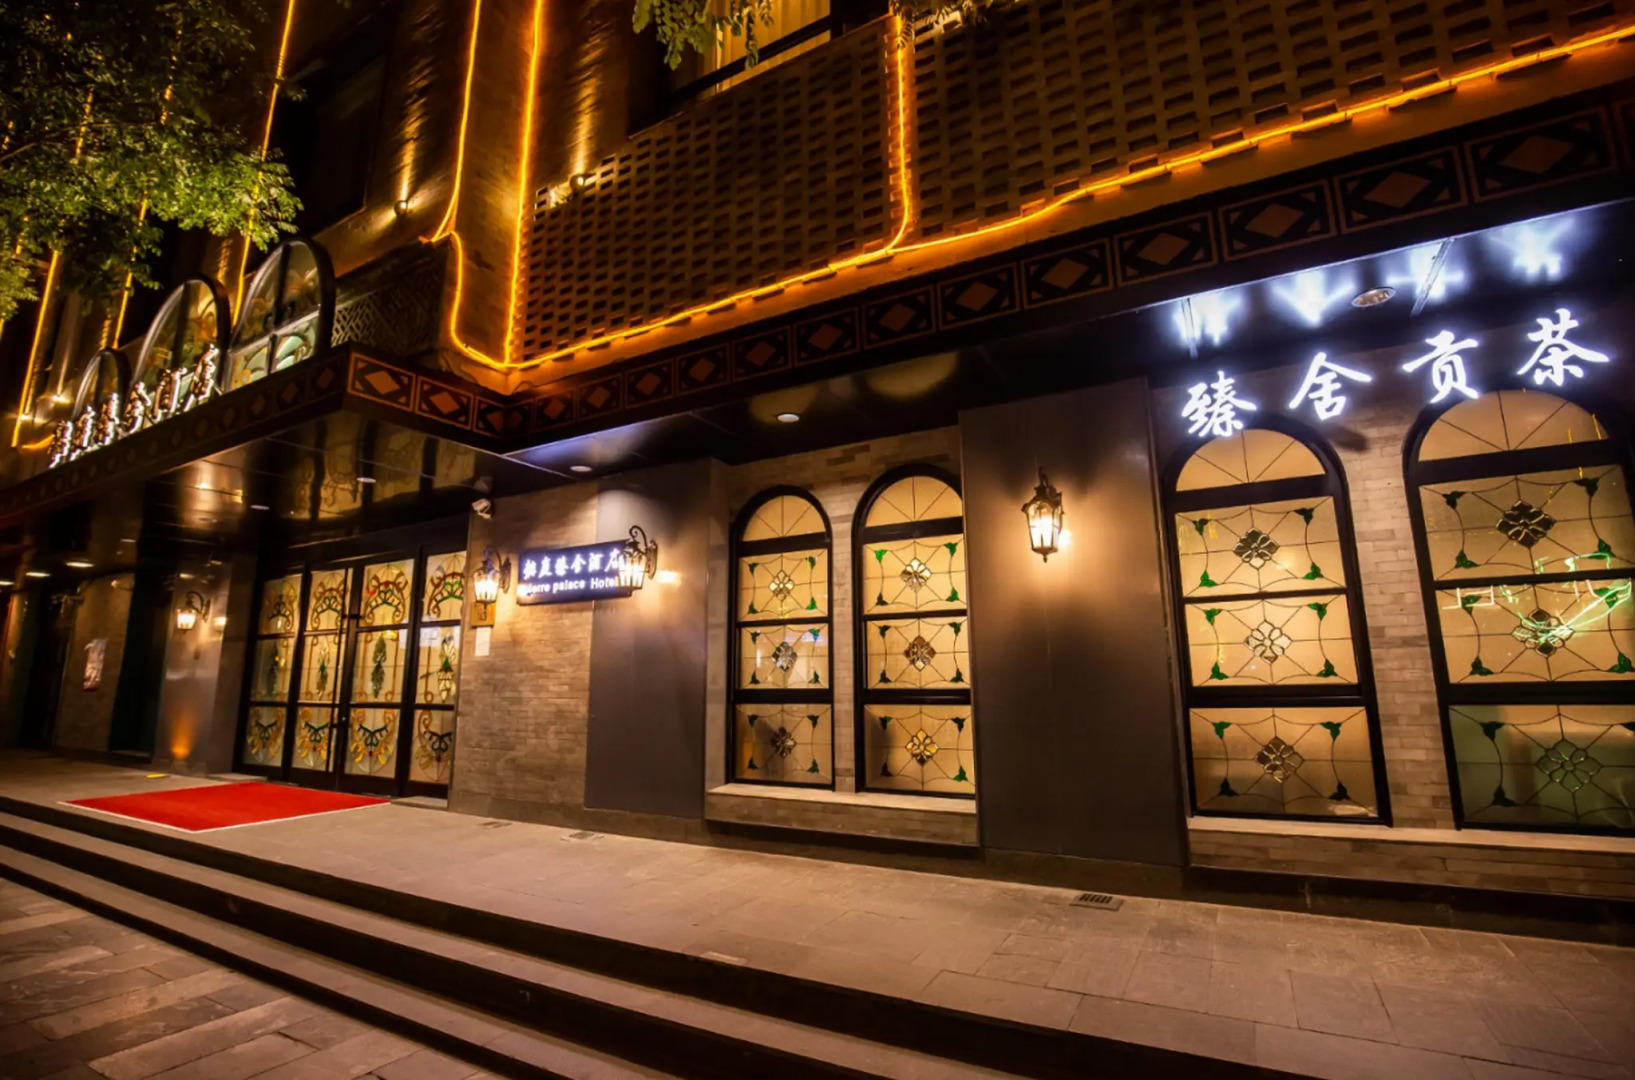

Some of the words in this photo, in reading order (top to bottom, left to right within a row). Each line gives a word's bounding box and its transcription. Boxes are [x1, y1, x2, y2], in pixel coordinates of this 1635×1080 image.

[1180, 307, 1611, 437] 臻舍贡茶
[520, 582, 550, 596] ierre
[552, 579, 585, 594] palace
[591, 576, 619, 589] Hotel
